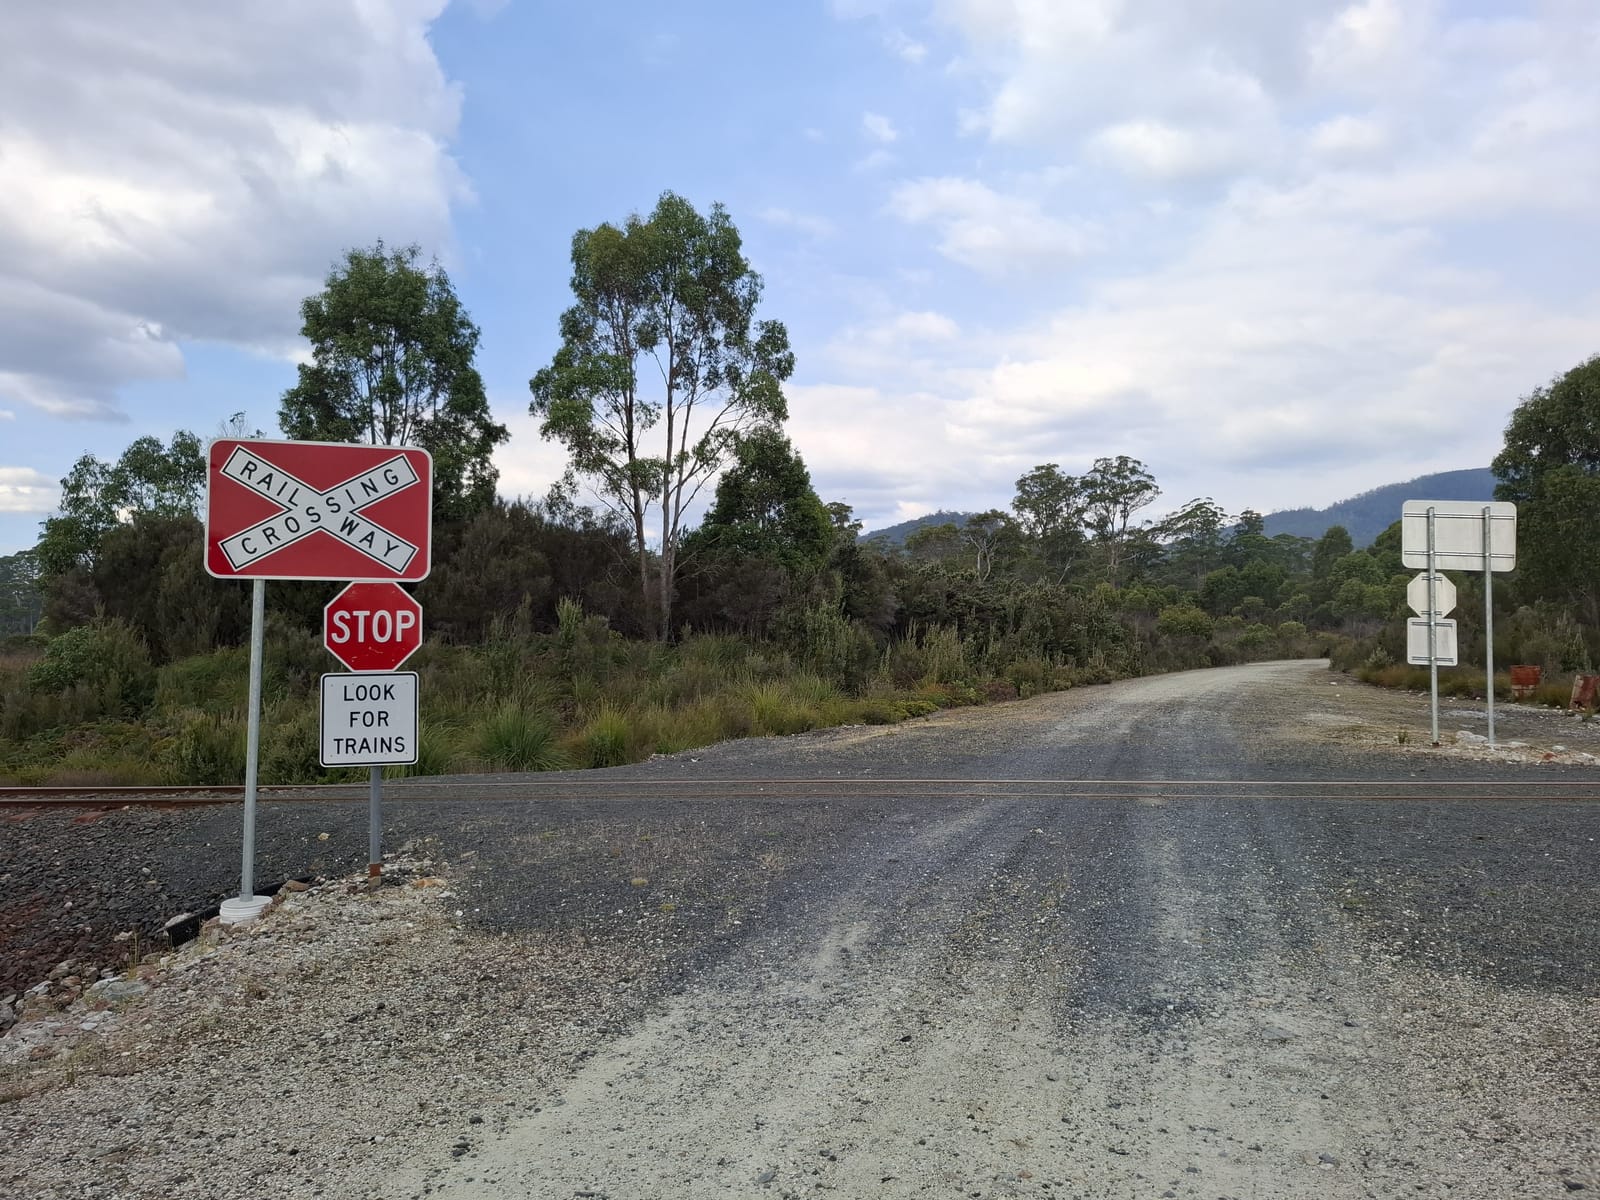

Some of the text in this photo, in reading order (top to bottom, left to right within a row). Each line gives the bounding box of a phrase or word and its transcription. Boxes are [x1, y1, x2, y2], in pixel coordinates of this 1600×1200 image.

[241, 468, 399, 555] CROSSING
[331, 610, 416, 644] STOP
[343, 684, 396, 702] LOOK
[350, 710, 389, 728] FOR
[333, 736, 405, 755] TRAINS
